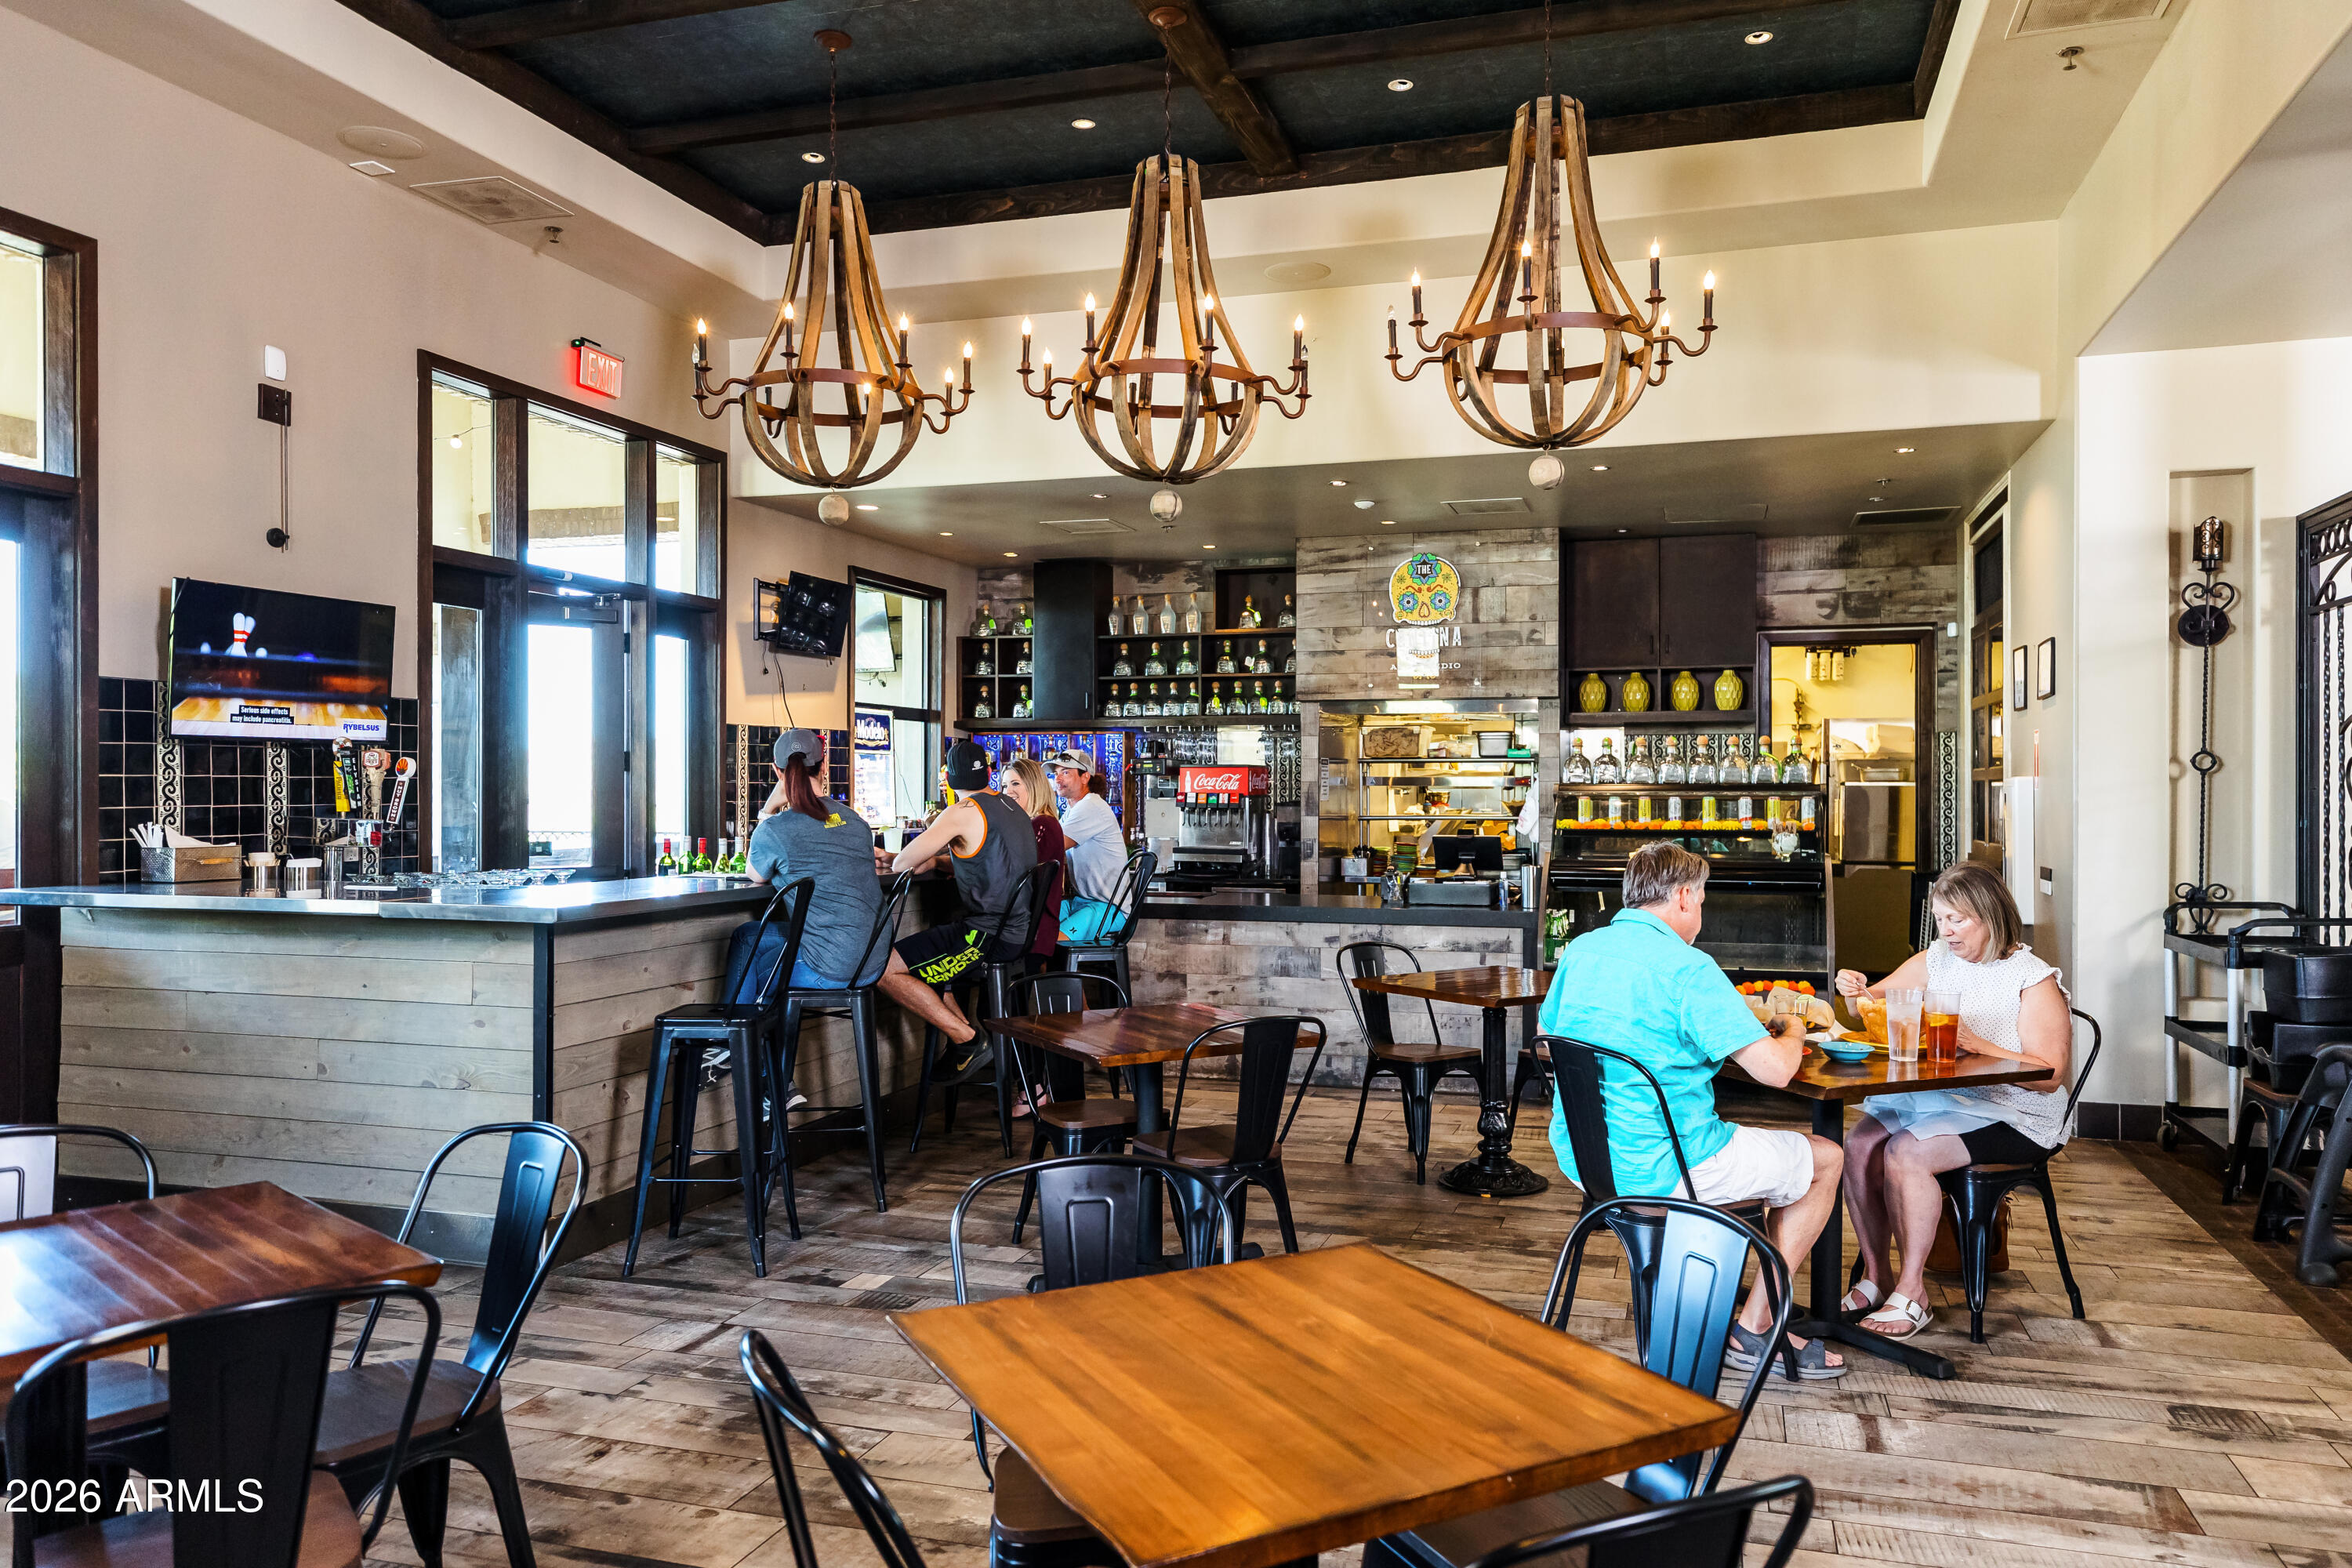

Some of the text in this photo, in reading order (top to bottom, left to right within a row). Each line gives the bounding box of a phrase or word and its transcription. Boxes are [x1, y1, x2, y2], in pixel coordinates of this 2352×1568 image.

[587, 352, 617, 394] EXIT
[1417, 564, 1432, 575] THE
[343, 723, 380, 734] RYBELSUS
[856, 719, 885, 741] Modelo
[352, 757, 361, 807] ELYSIAN
[1193, 773, 1243, 790] Coca-Cola
[918, 946, 980, 978] UNDER
